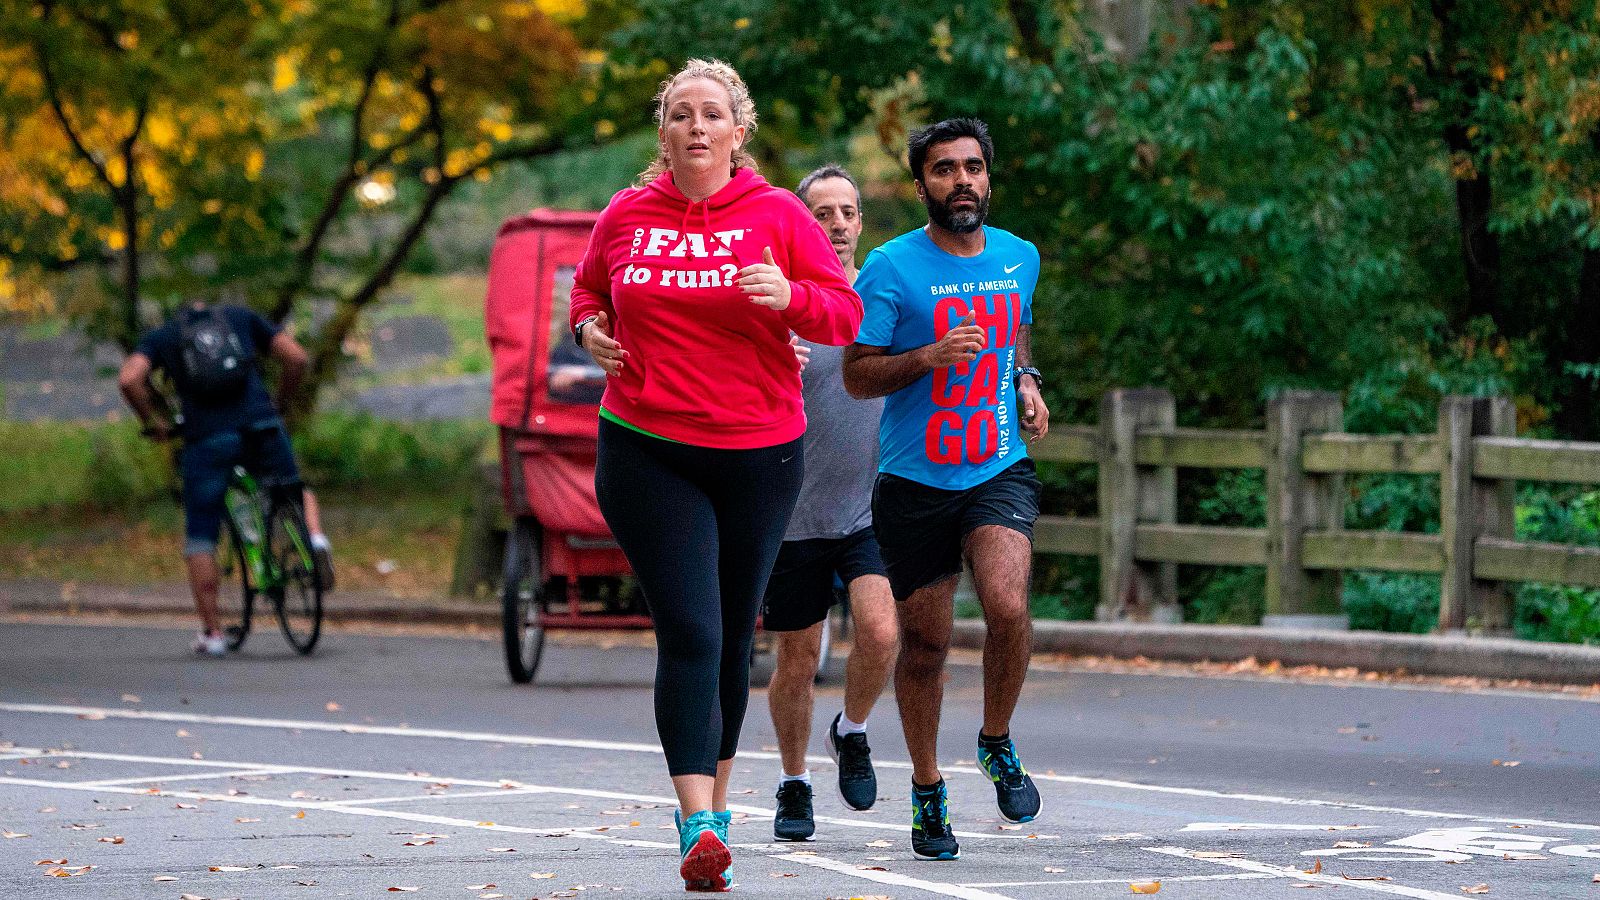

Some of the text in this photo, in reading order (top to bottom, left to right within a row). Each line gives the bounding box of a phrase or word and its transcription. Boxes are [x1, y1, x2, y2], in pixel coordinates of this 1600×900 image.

[630, 228, 645, 258] TOO
[643, 228, 744, 258] FAT
[622, 263, 738, 288] to run?
[930, 279, 1019, 296] BANK OF AMERICA
[933, 293, 1021, 350] CHI
[931, 352, 1000, 408] CA
[997, 349, 1014, 425] MARAON
[925, 409, 998, 465] GO
